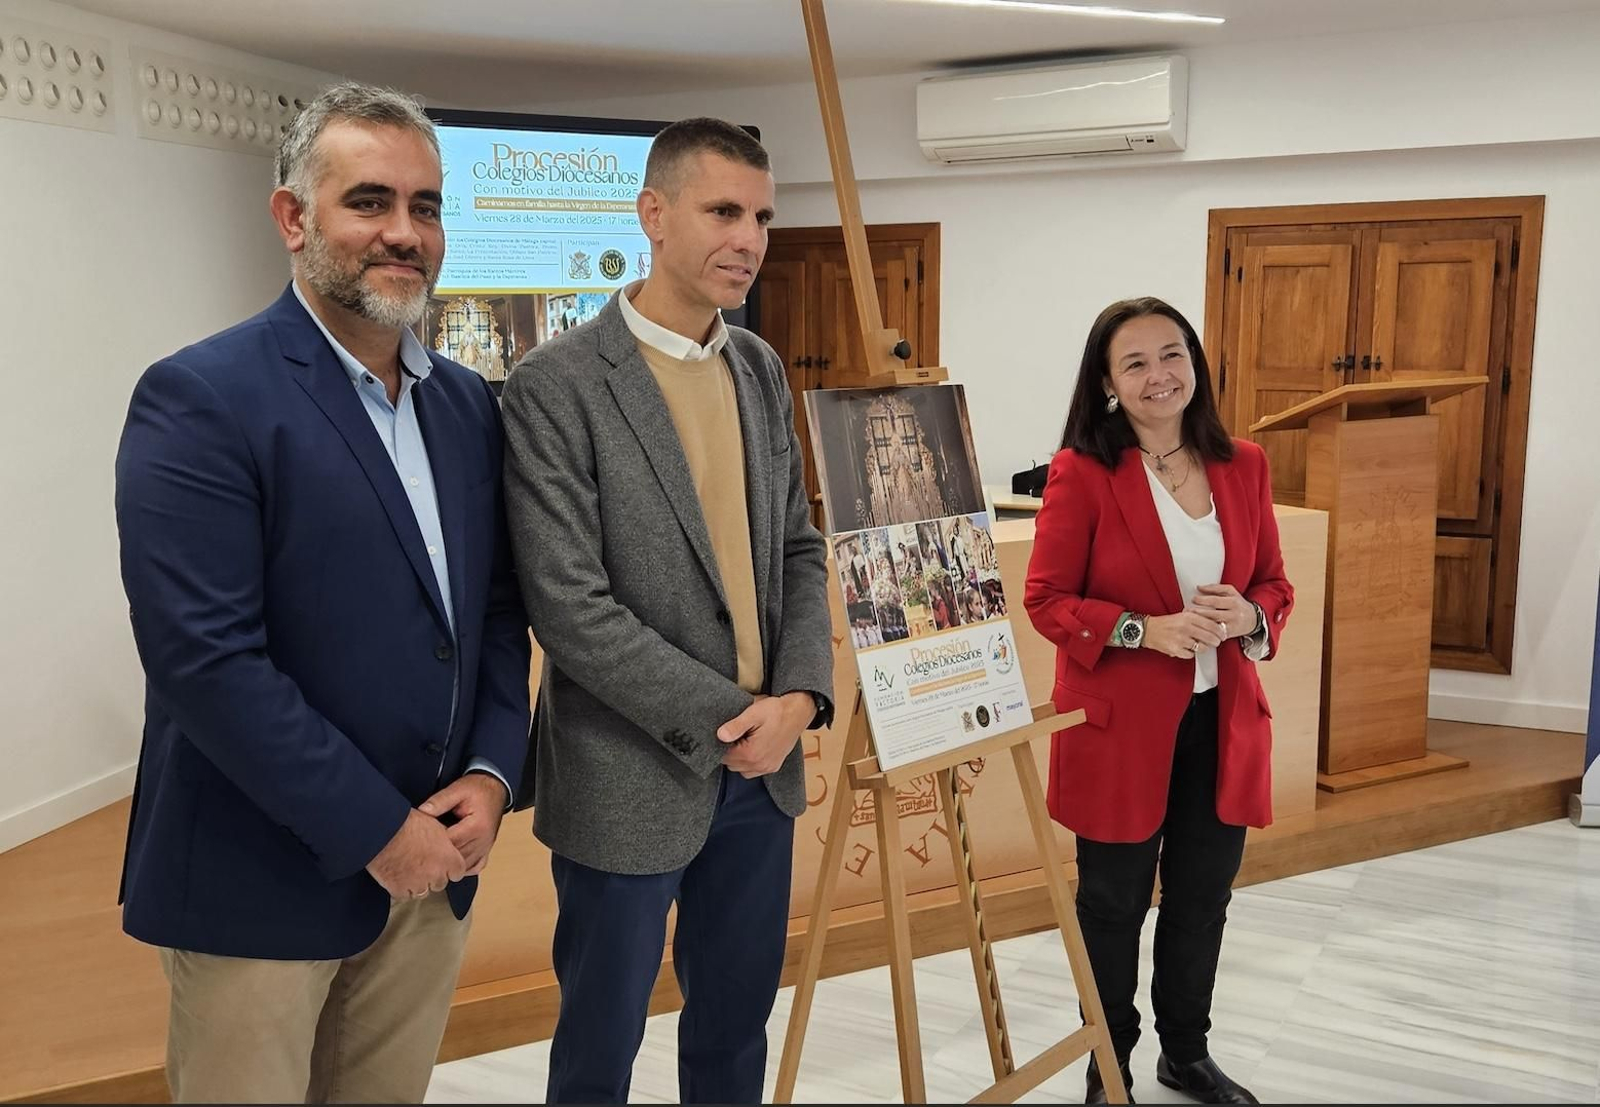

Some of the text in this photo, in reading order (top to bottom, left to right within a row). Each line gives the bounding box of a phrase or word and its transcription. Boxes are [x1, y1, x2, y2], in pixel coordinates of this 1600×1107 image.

[491, 142, 618, 171] Procesión
[473, 162, 545, 186] Colegios
[473, 184, 639, 199] Con motivo del Jubileo 2025
[474, 213, 509, 223] Viernes
[510, 214, 522, 223] 28
[523, 214, 534, 223] de
[536, 214, 564, 224] Marzo
[904, 656, 939, 676] Colegios
[939, 649, 982, 667] Diocesanos
